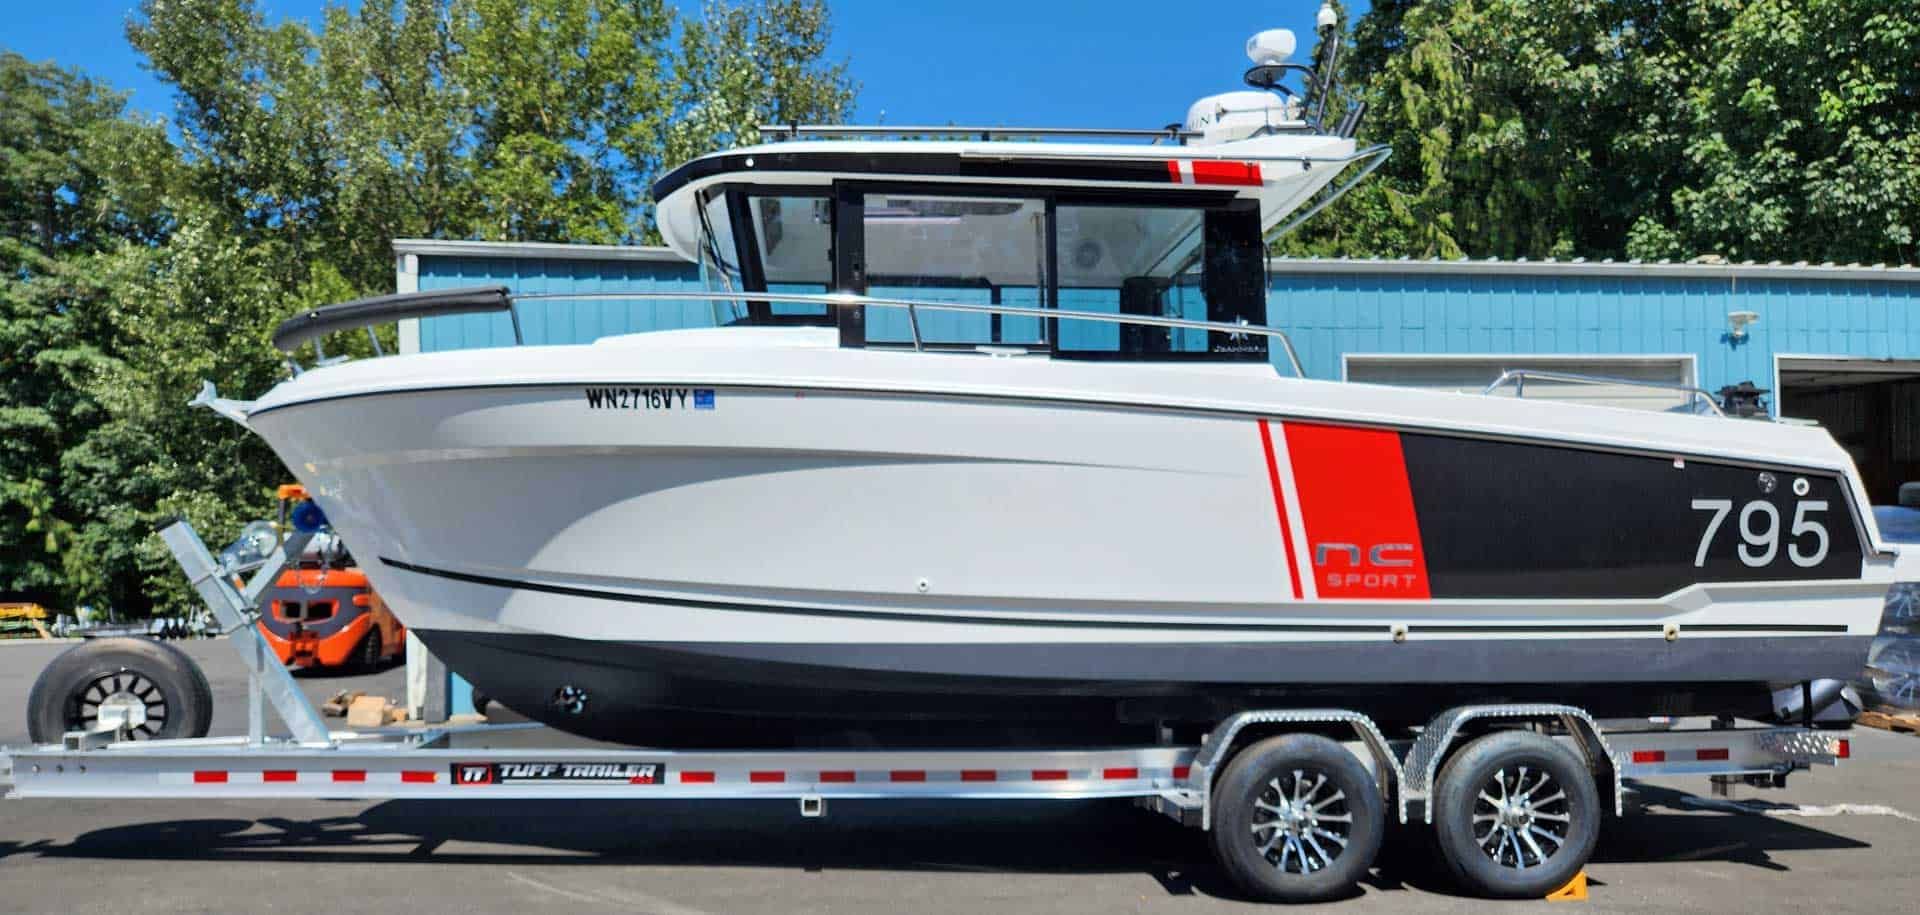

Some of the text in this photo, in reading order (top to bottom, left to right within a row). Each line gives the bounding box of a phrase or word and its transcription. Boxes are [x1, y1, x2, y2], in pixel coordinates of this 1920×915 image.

[585, 388, 688, 409] WN2716VY
[1691, 499, 1829, 567] 795
[1327, 573, 1417, 588] SPORT
[500, 764, 657, 778] TUFF TRAILER
